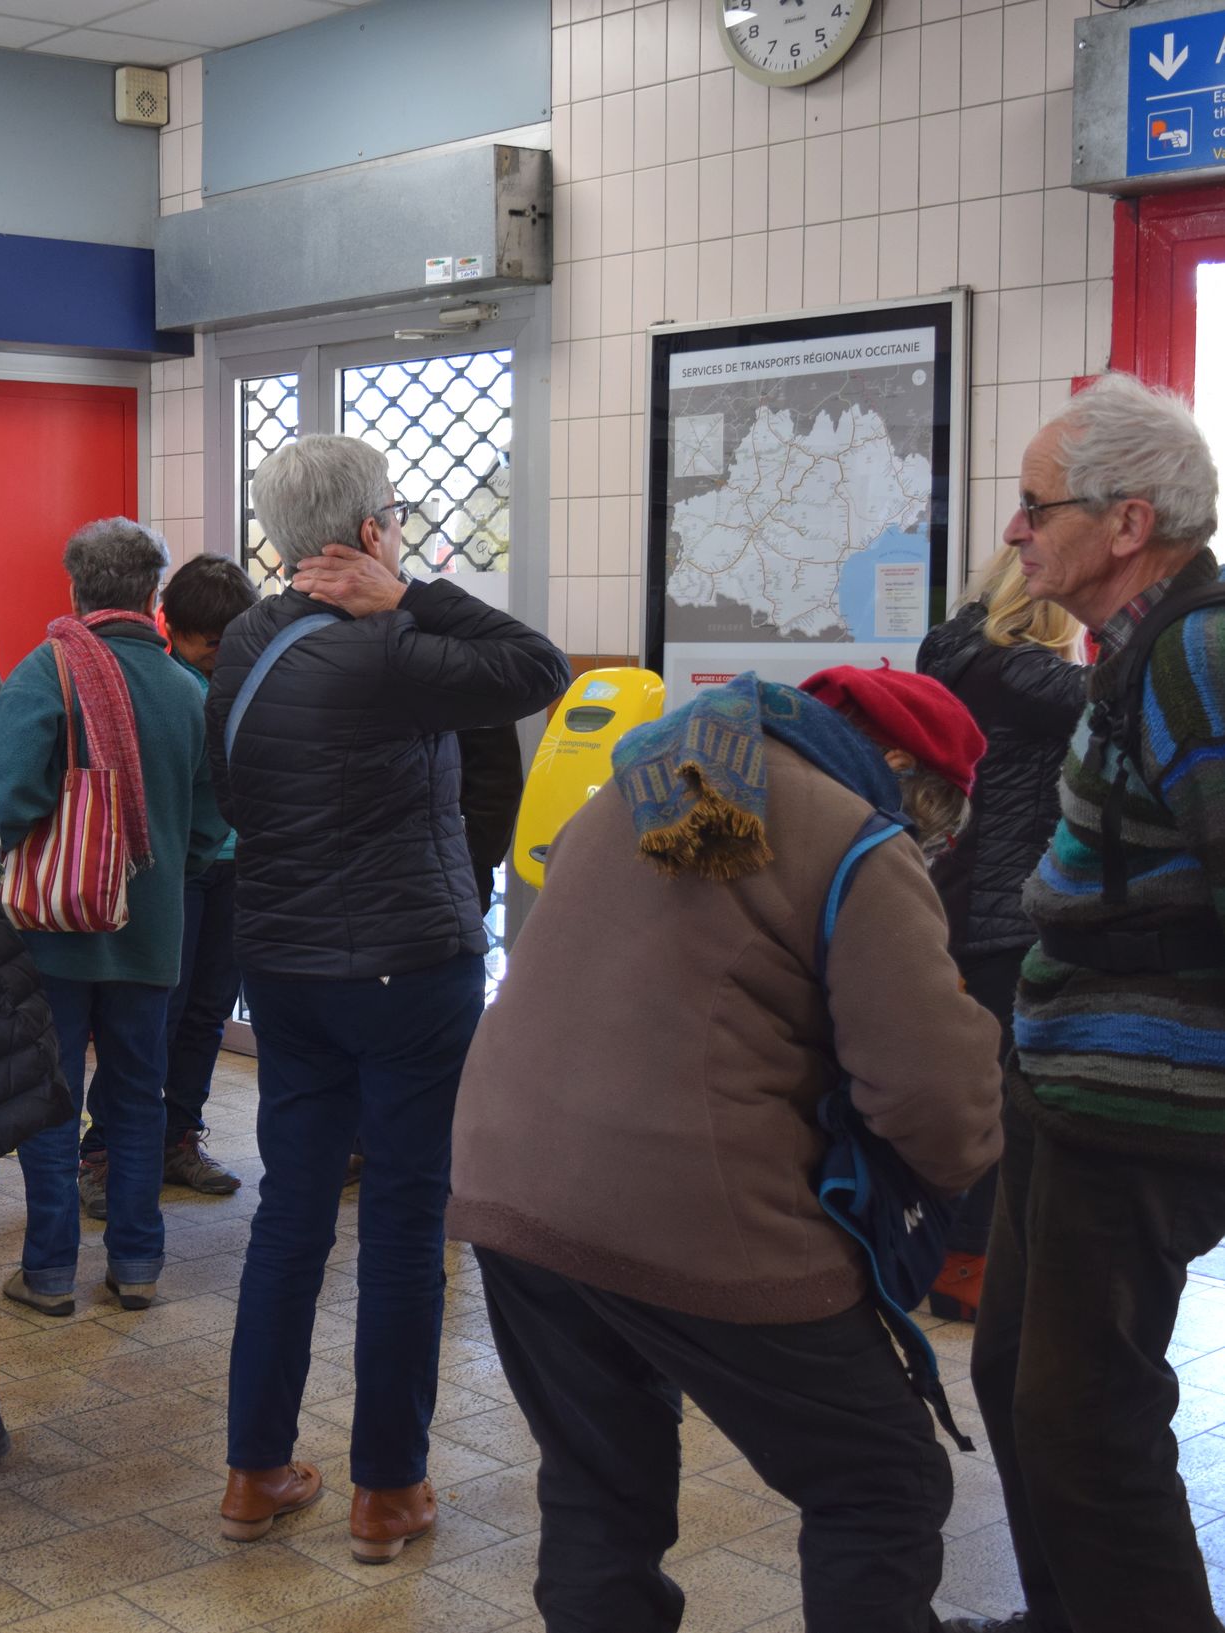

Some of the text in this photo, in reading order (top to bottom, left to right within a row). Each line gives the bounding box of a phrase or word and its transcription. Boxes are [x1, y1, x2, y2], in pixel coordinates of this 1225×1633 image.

[831, 4, 842, 18] 4
[748, 25, 760, 38] 8
[815, 28, 825, 43] 5
[768, 40, 777, 55] 7
[790, 43, 801, 57] 6
[682, 341, 920, 378] SERVICES DE TRANSPORTS RÉGIONAUX OCCITANIE
